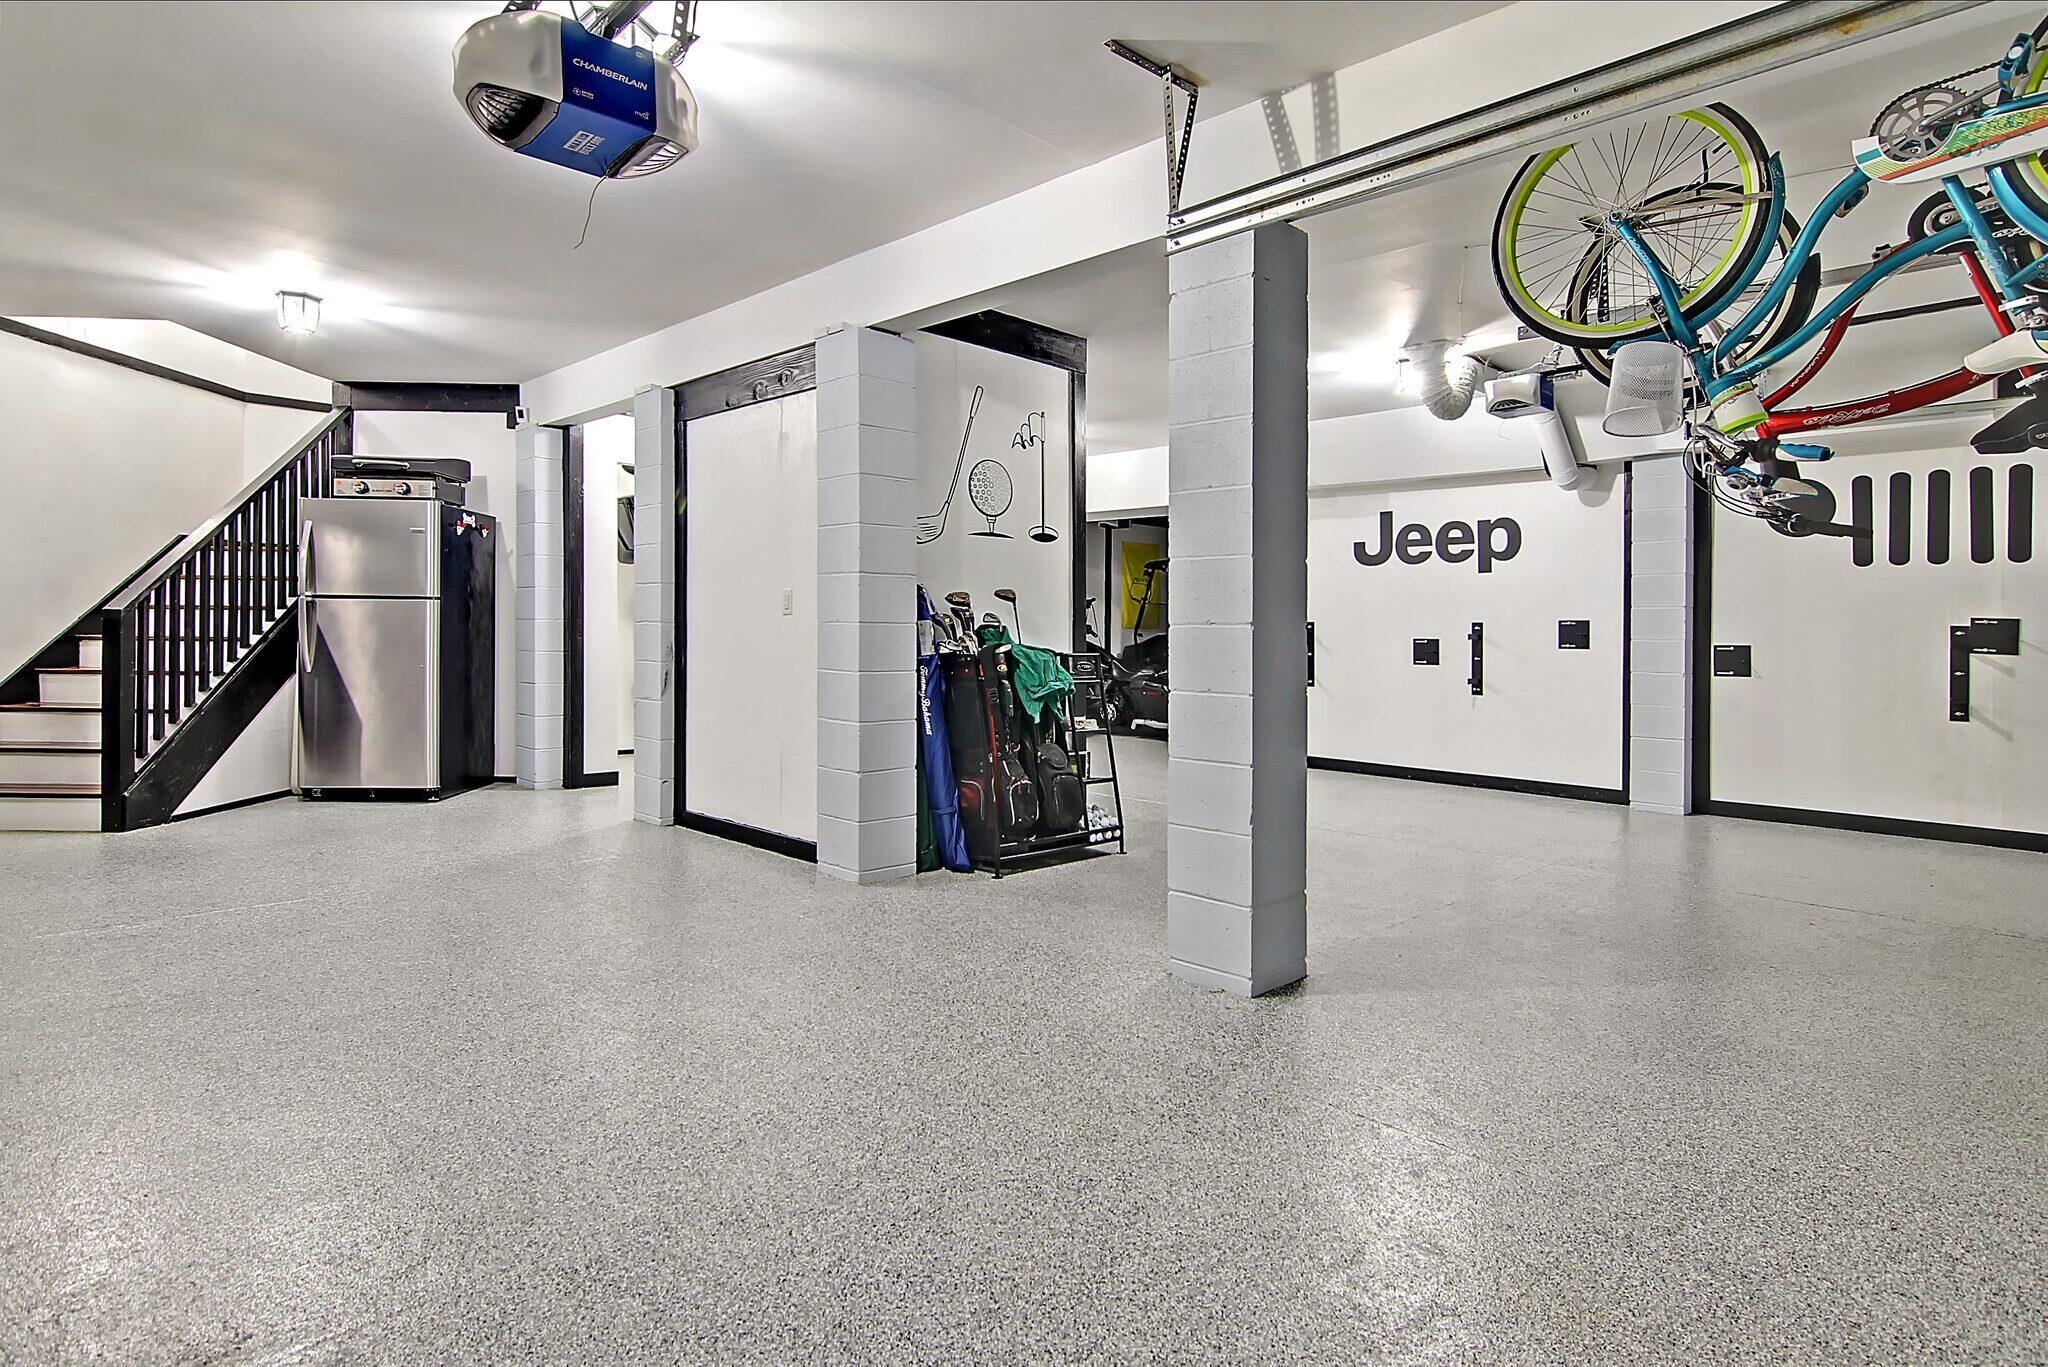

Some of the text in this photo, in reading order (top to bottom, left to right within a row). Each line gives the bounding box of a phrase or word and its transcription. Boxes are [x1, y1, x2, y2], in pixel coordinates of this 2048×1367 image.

[572, 58, 648, 91] CHAMBERLAIN
[1790, 347, 1826, 388] ALUMINUM
[1353, 510, 1522, 574] Jeep
[918, 665, 933, 736] Tommy Bahama
